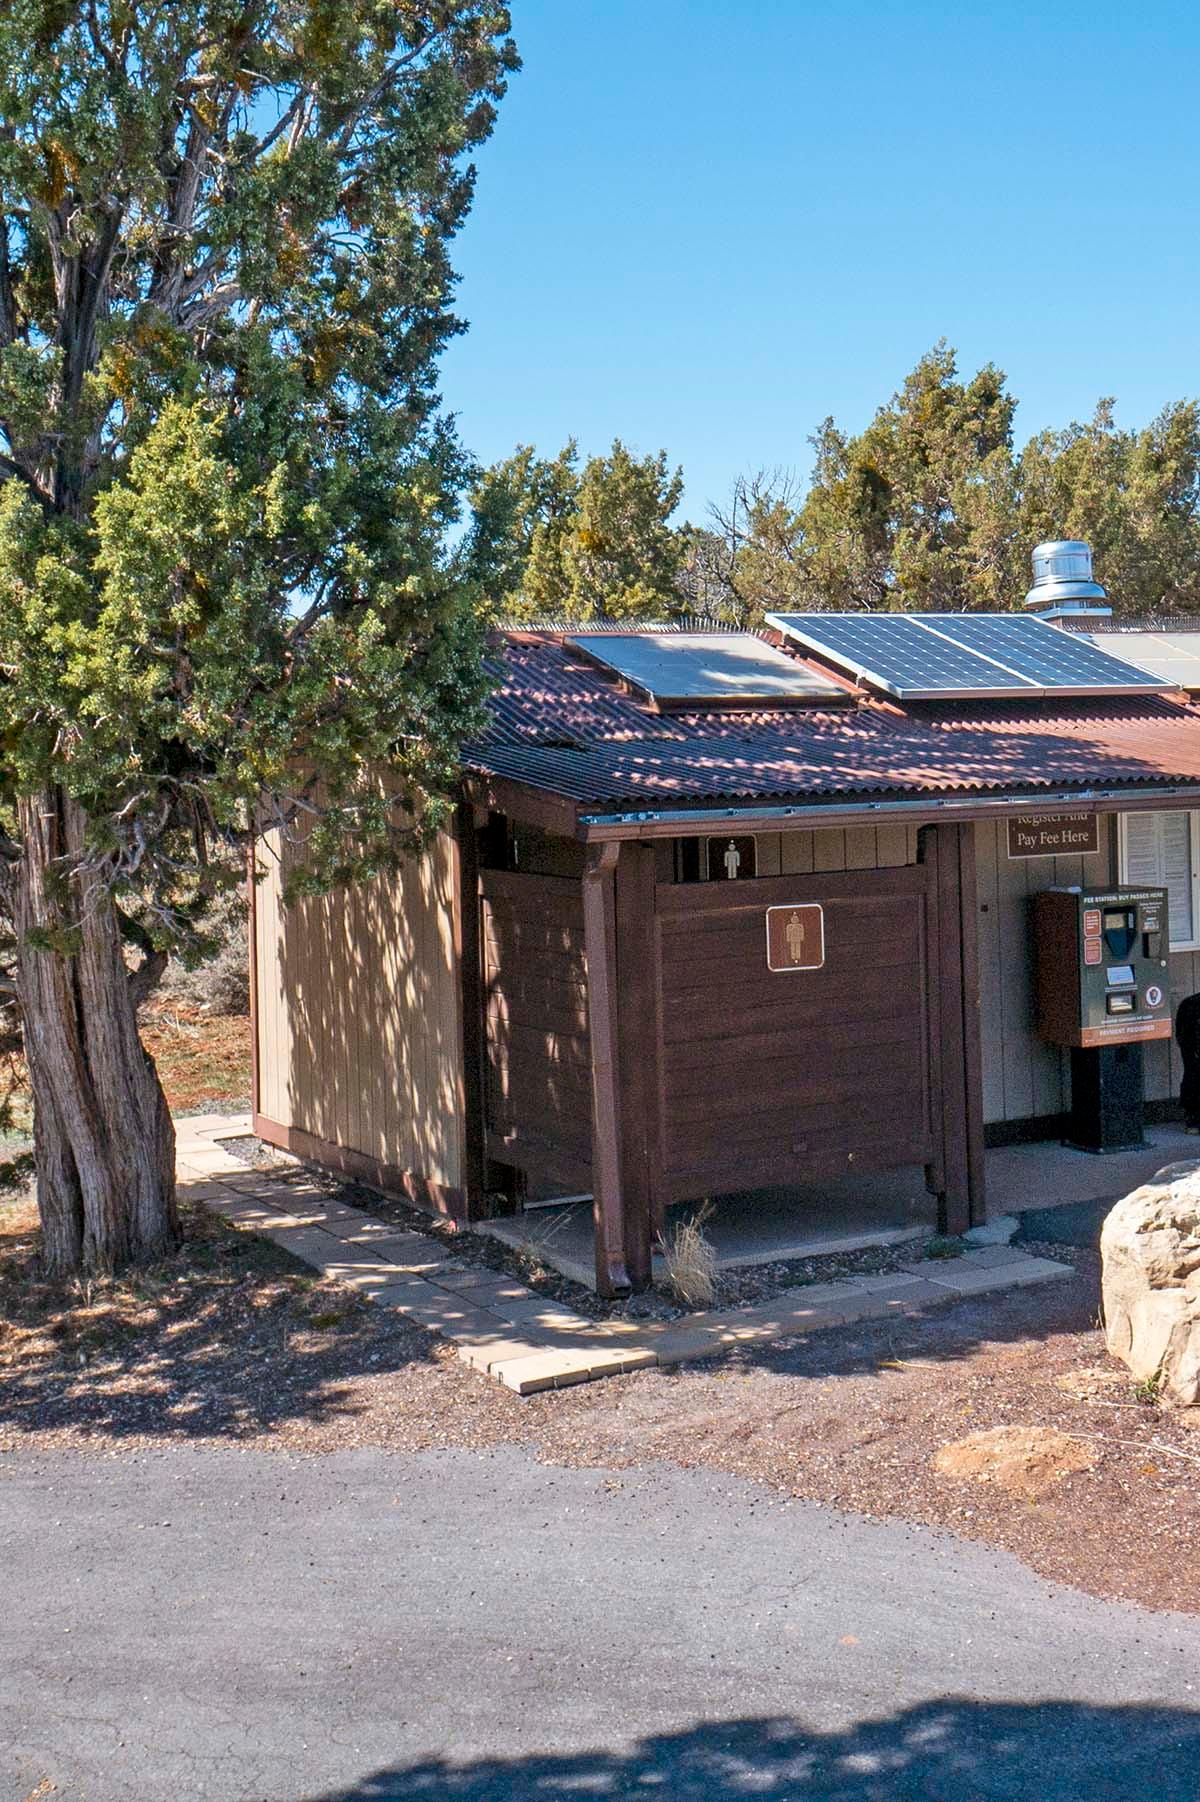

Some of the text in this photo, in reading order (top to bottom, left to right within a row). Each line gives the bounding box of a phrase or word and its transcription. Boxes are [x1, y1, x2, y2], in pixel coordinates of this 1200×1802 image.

[1018, 830, 1089, 848] Pay Fee Here
